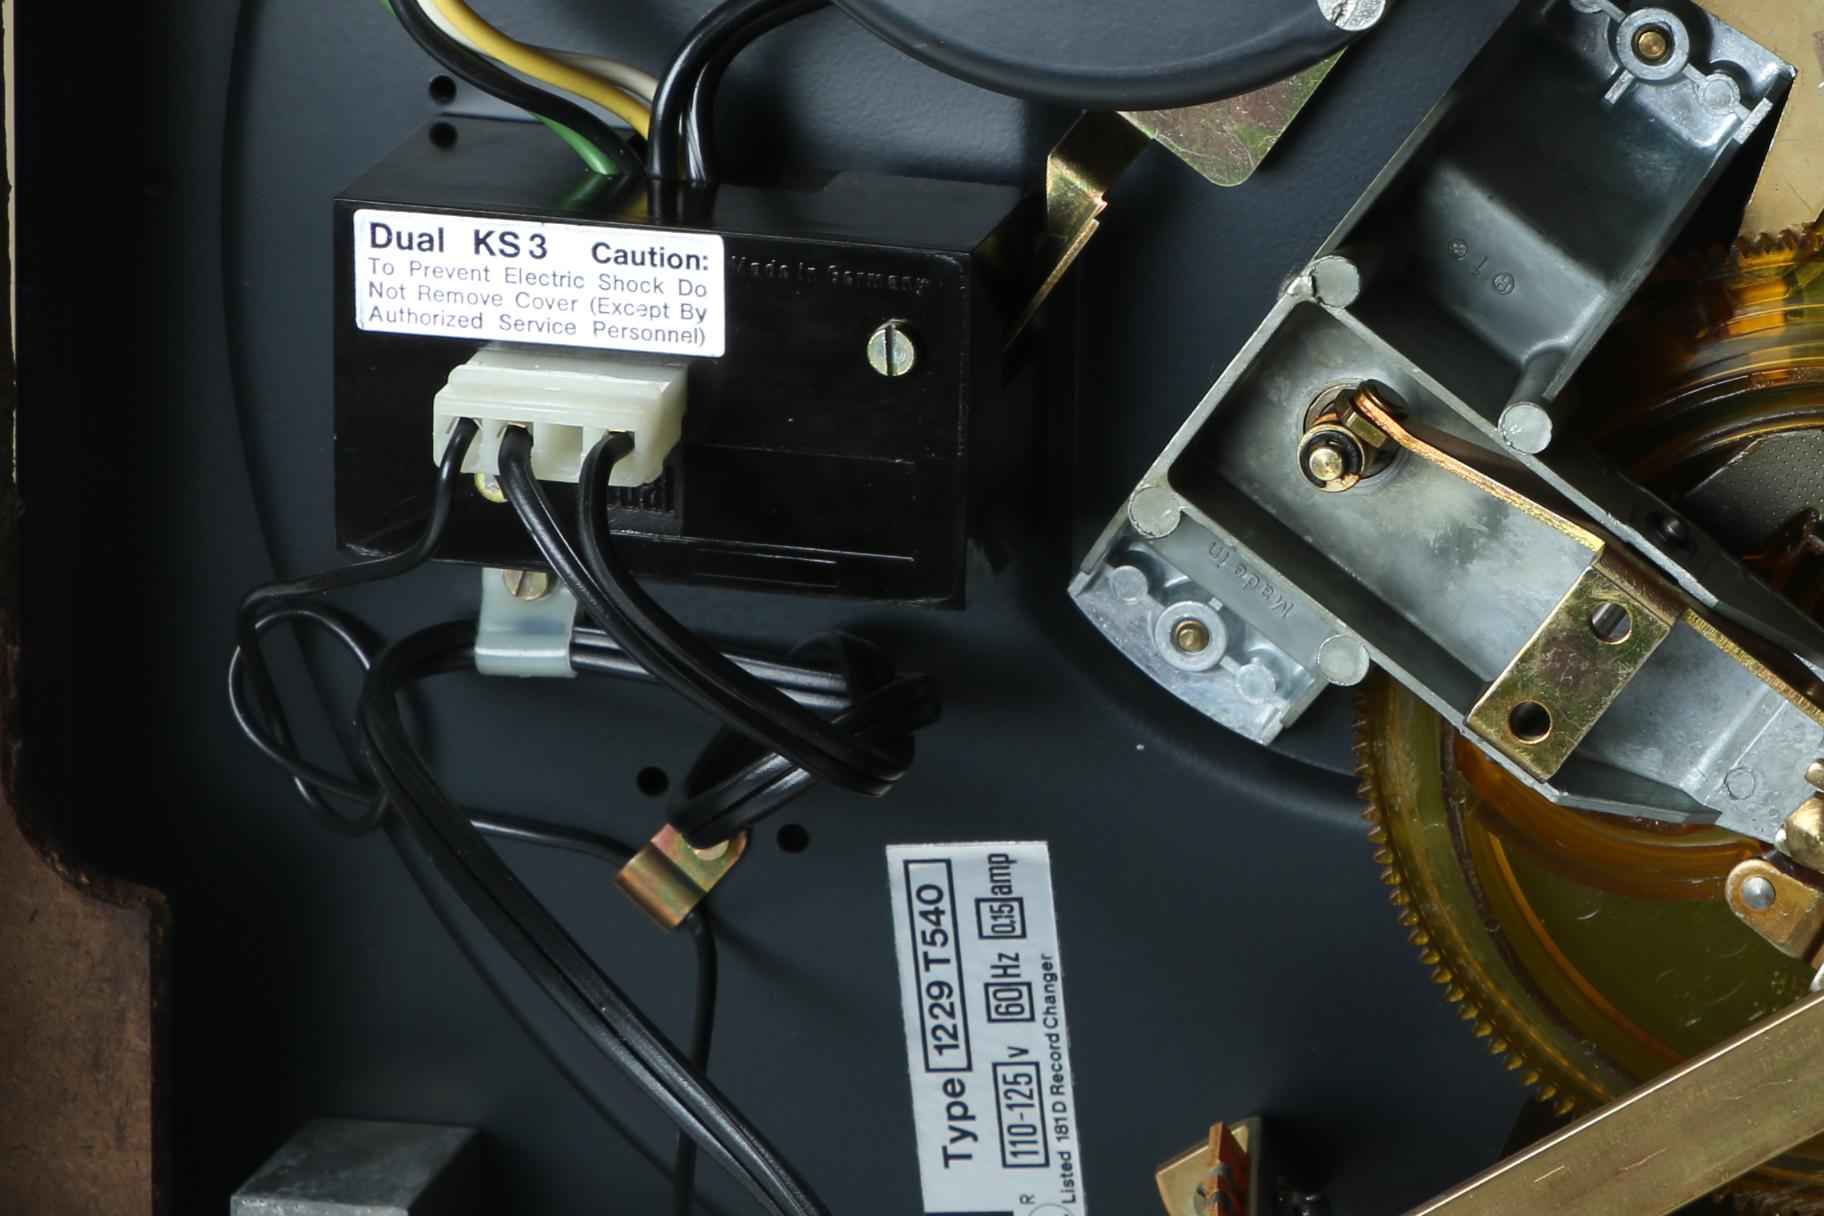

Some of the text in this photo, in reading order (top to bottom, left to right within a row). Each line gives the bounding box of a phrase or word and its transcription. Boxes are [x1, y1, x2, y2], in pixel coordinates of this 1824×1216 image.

[368, 221, 445, 254] Dual
[591, 241, 710, 272] Caution:
[367, 257, 708, 299] To Prevent Electric Shock Do
[367, 281, 709, 325] Not Remove Cover (Except By
[368, 305, 706, 348] Authorized Service Personnel)
[1208, 541, 1295, 619] Made in
[987, 852, 1018, 896] amp
[990, 951, 1022, 979] Hz
[1041, 952, 1059, 1029] Changer
[915, 883, 978, 1169] Type 1229 T540
[992, 987, 1026, 1016] 60
[1044, 1032, 1066, 1096] Record
[1002, 1072, 1040, 1159] 110-125
[1057, 1150, 1077, 1204] Listed
